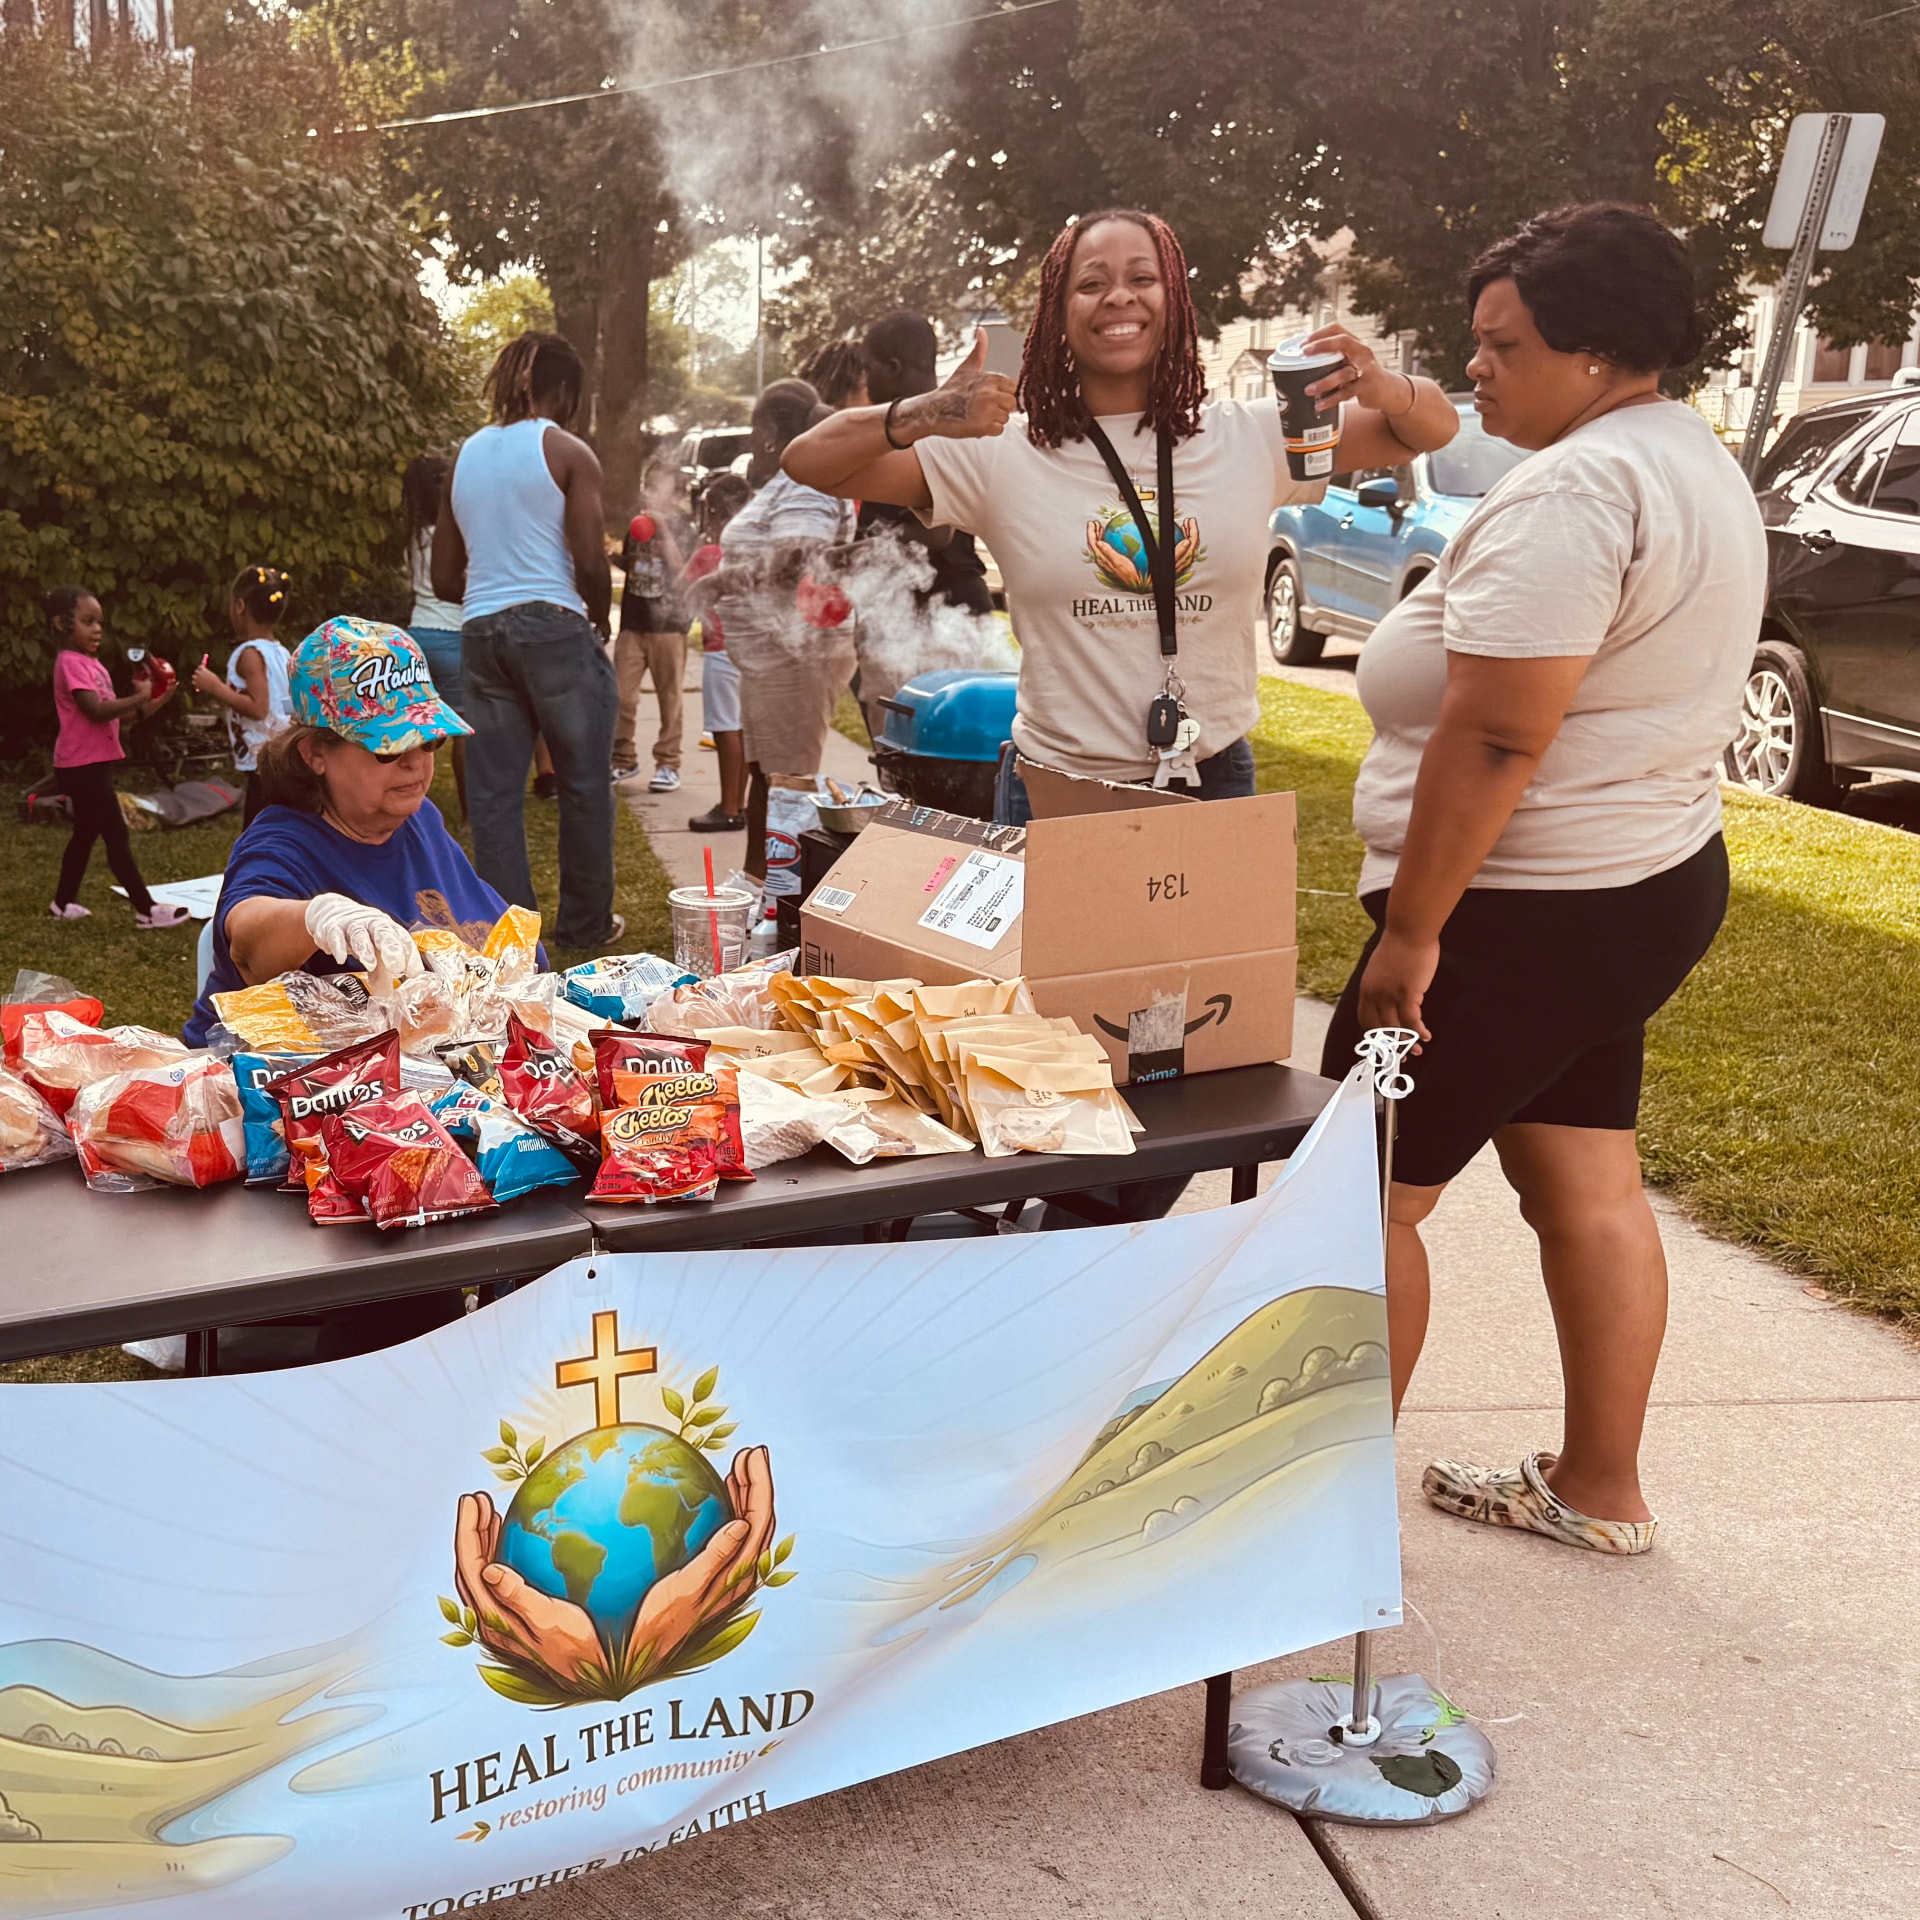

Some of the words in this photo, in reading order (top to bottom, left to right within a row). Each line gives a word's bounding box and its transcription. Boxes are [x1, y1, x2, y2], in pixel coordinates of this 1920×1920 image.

[1073, 598, 1124, 617] HEAL
[1126, 599, 1157, 612] THE
[1174, 595, 1213, 612] AND
[1147, 873, 1190, 902] 134
[523, 1054, 571, 1079] Dori
[626, 1056, 693, 1074] Dorito
[1137, 1068, 1178, 1083] prime
[292, 1080, 384, 1118] Doritos
[641, 1076, 715, 1106] Cheetos
[613, 1107, 691, 1139] Cheetos
[517, 1136, 551, 1152] ORIGINAL
[429, 1734, 569, 1823] HEAL
[579, 1708, 655, 1763] THE
[668, 1689, 816, 1741] LAND
[498, 1782, 607, 1830] restoring
[616, 1748, 756, 1796] community
[402, 1858, 607, 1920] TOGETHER
[619, 1840, 661, 1864] IN
[667, 1790, 767, 1847] FAITH
